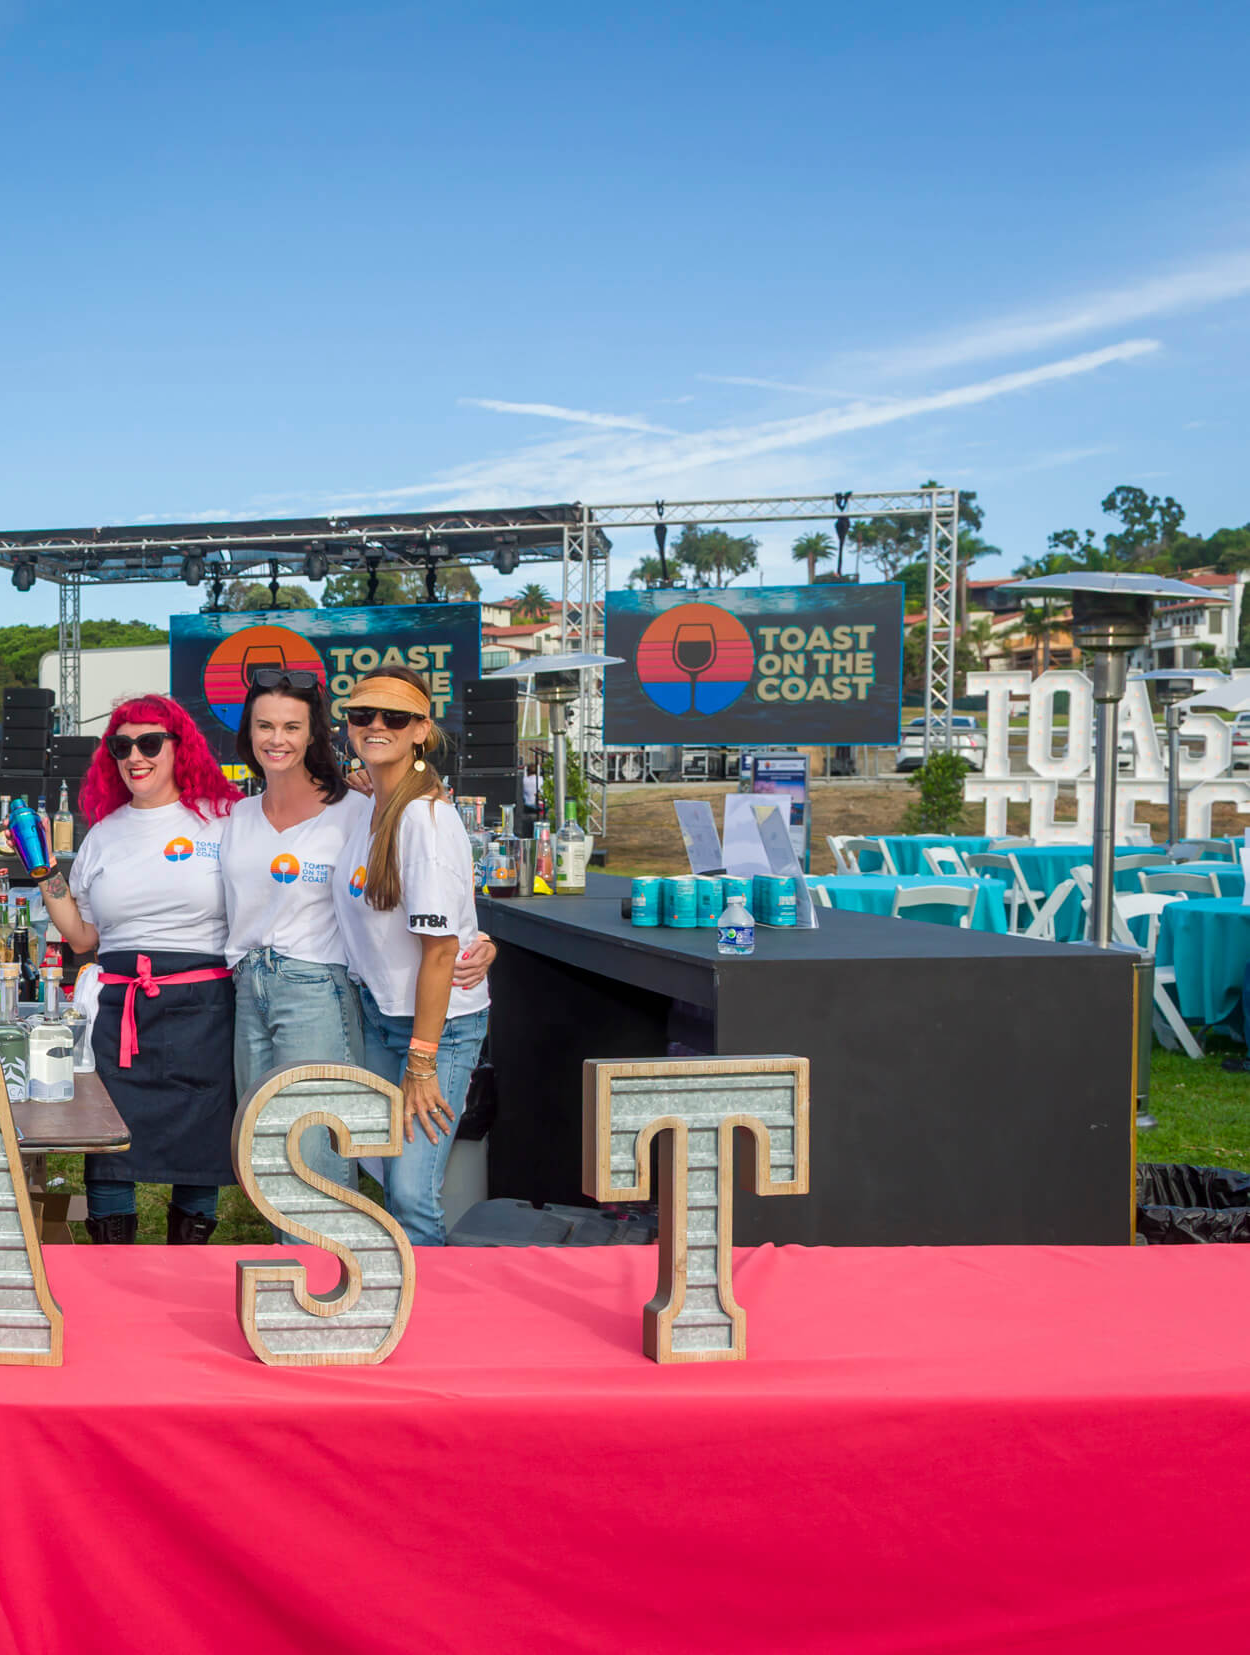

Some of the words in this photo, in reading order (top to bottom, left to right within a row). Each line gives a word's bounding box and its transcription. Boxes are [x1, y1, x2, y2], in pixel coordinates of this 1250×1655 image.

[757, 625, 876, 651] TOAST
[330, 644, 452, 672] TOAST
[758, 653, 806, 676] ON
[813, 652, 875, 675] THE
[757, 676, 875, 702] COAST
